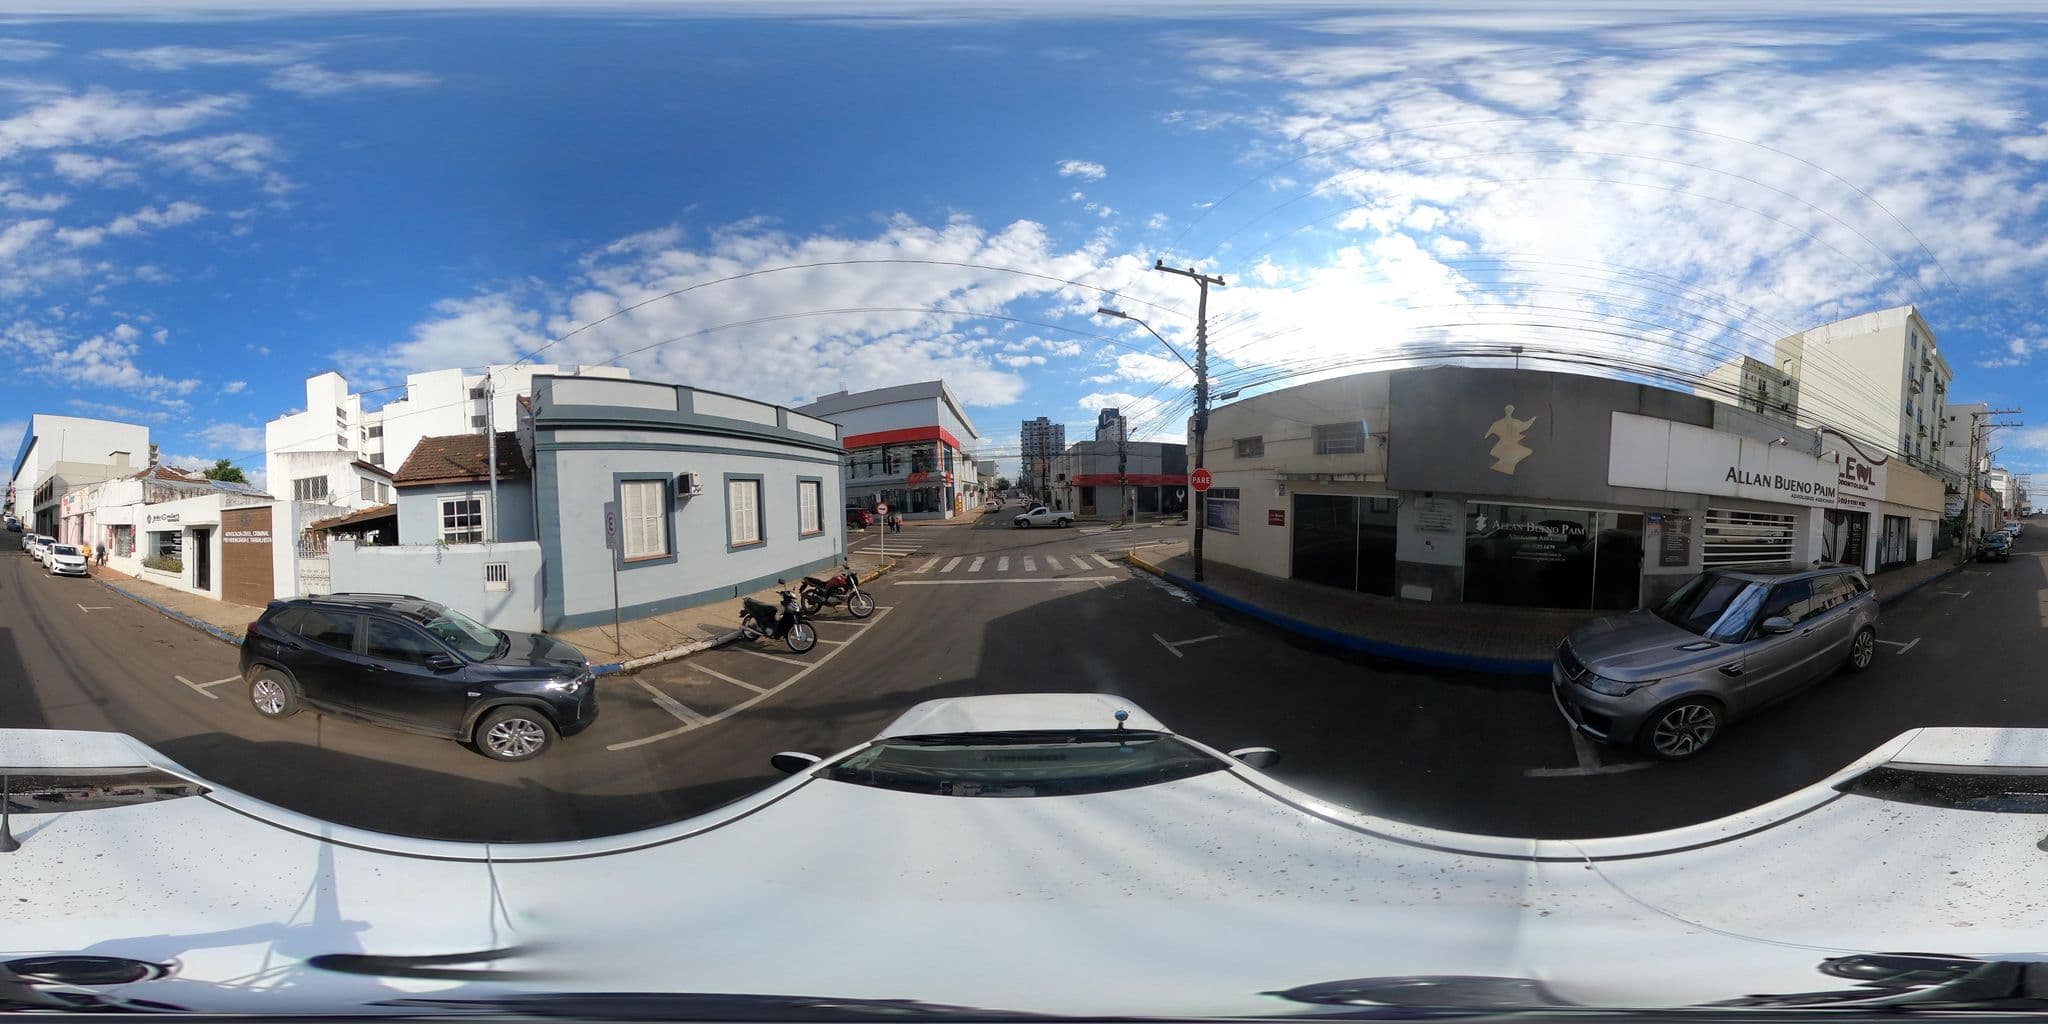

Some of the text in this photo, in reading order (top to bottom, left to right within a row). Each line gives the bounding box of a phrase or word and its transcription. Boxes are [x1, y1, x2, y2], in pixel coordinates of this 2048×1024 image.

[1192, 476, 1210, 485] PARE
[1725, 466, 1836, 498] ALLAN BUENO PAIM
[1492, 519, 1585, 536] ALLAN BUENO PAIM
